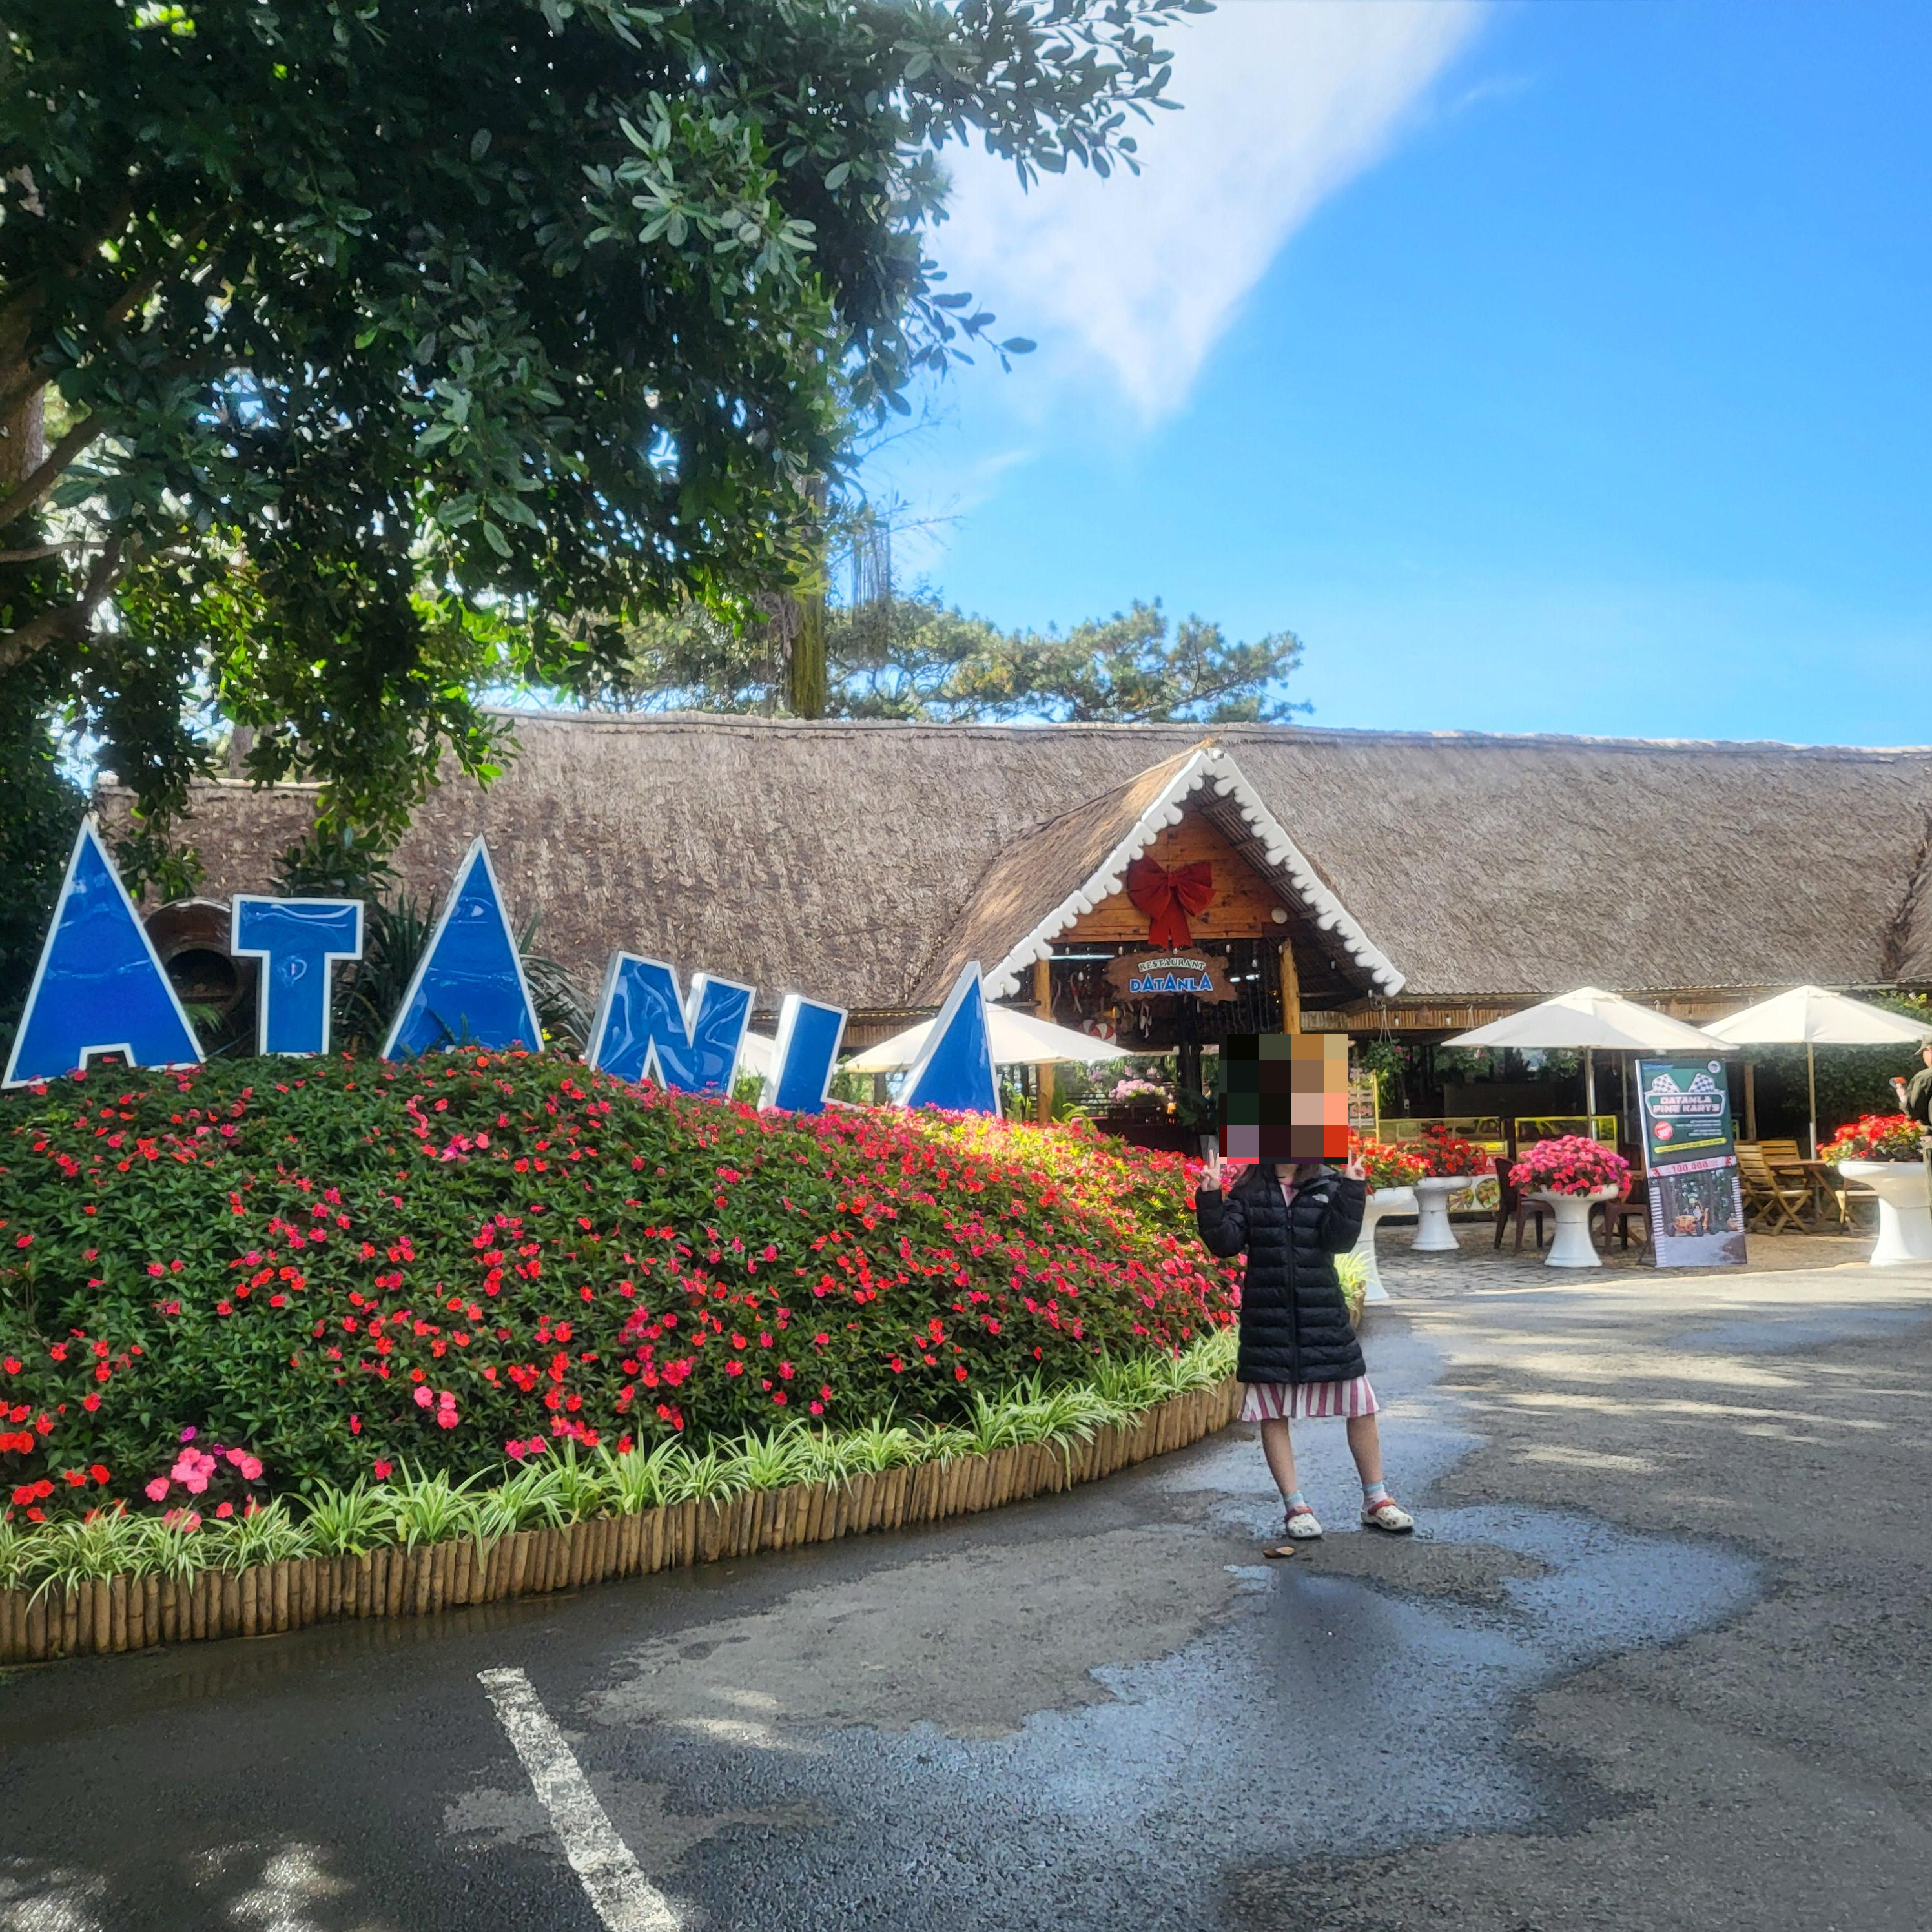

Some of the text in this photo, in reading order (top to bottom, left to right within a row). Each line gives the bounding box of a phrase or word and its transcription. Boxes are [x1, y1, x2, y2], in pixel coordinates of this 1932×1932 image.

[1138, 958, 1206, 972] RESTAURANT
[1129, 971, 1213, 992] DATANLA
[1660, 1096, 1712, 1104] DATANLA
[1683, 1104, 1720, 1113] KARTS
[1672, 1161, 1709, 1173] 100.000
